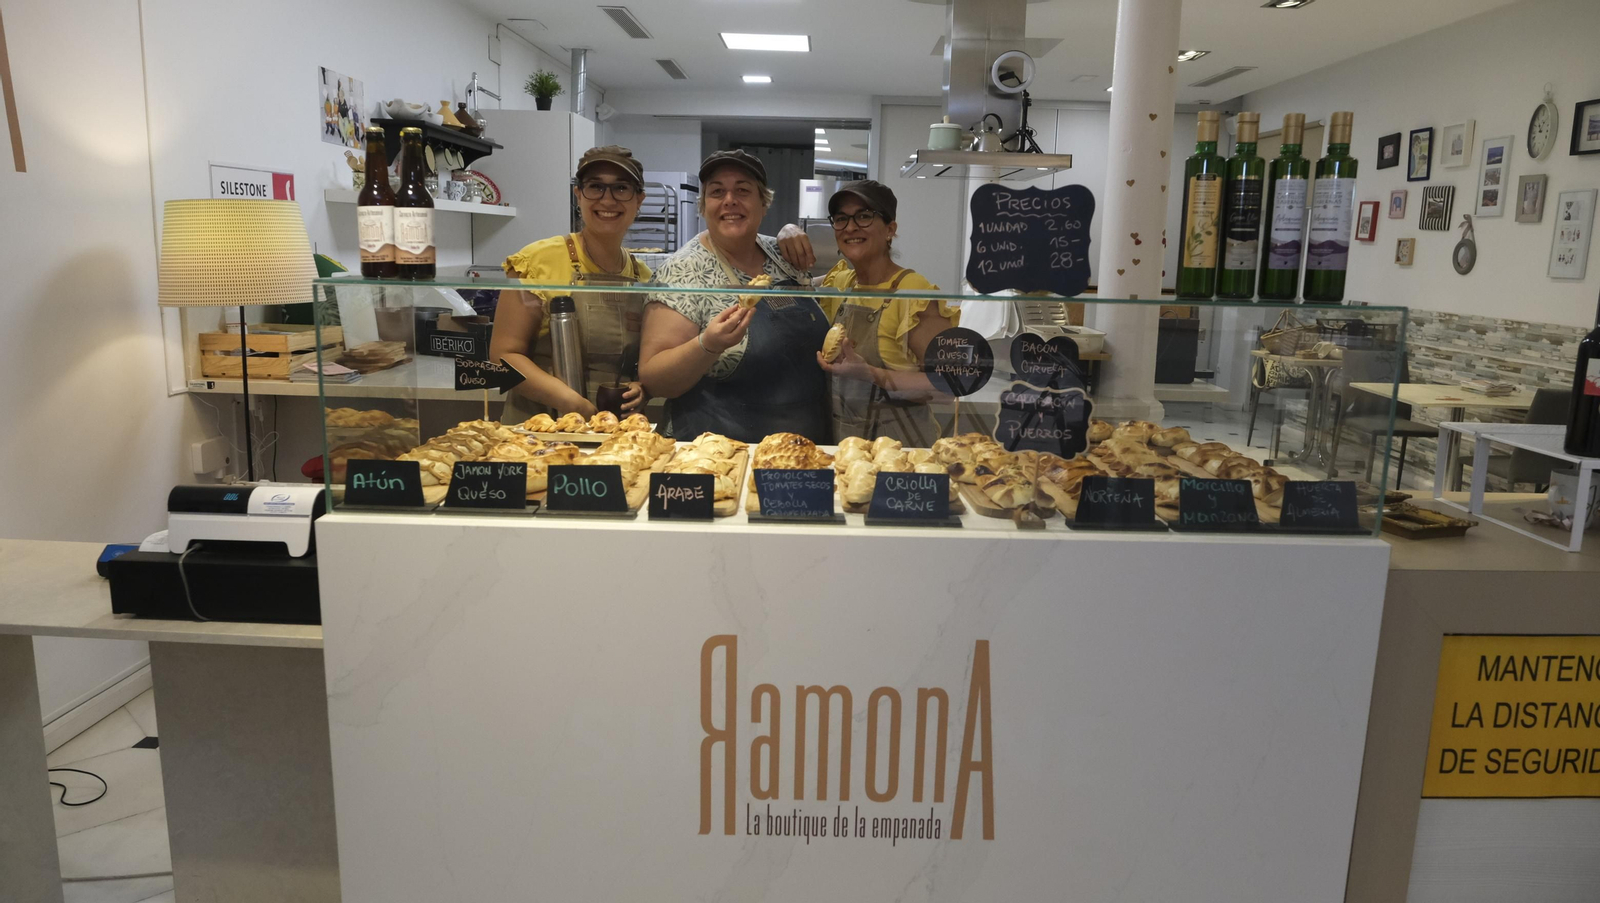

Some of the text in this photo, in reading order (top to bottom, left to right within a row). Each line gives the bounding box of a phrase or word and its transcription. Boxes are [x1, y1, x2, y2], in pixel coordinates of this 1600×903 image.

[220, 180, 267, 197] SILESTONE
[992, 192, 1071, 211] PRECIOS
[976, 240, 987, 254] 6
[977, 259, 998, 275] 12
[432, 337, 473, 352] IBÉRIKO
[935, 335, 969, 348] TOMATE
[1021, 340, 1058, 354] BACON
[934, 364, 982, 377] ALBAHACA
[1005, 420, 1073, 440] PUERROS
[497, 463, 524, 480] YORK
[352, 470, 406, 492] Atún
[552, 473, 608, 498] Pollo
[804, 481, 832, 491] SECOS
[457, 486, 507, 501] QUESO
[1084, 488, 1144, 508] NORTEÑA
[762, 497, 808, 510] CEBOLLA
[885, 498, 934, 513] CARNE
[1451, 702, 1484, 729] LA
[1439, 748, 1478, 774] DE
[746, 803, 941, 847] La boutique de la empanada
